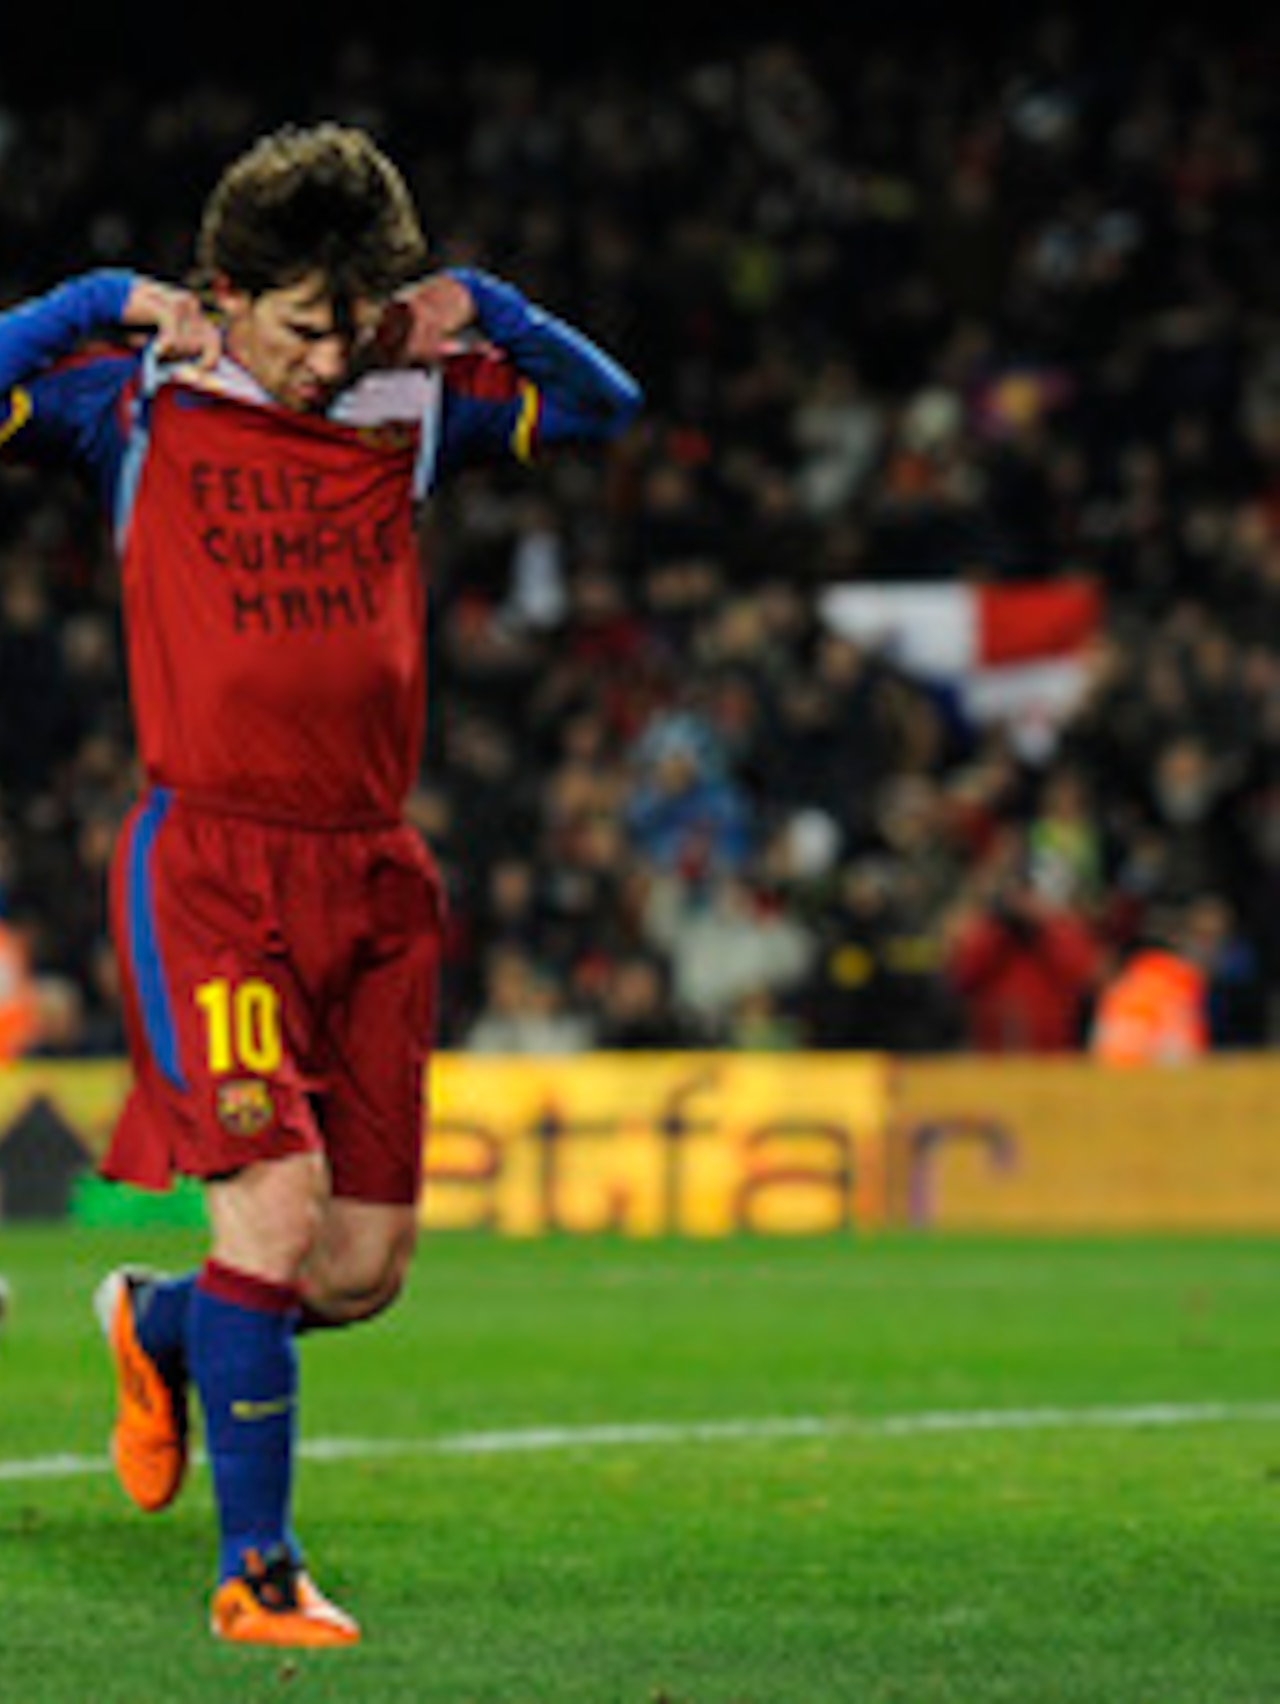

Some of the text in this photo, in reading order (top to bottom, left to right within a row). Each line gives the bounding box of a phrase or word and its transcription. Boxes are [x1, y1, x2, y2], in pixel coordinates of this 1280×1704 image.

[190, 459, 320, 512] FELIZ
[203, 518, 394, 570] CUMPLE
[193, 976, 282, 1074] 10
